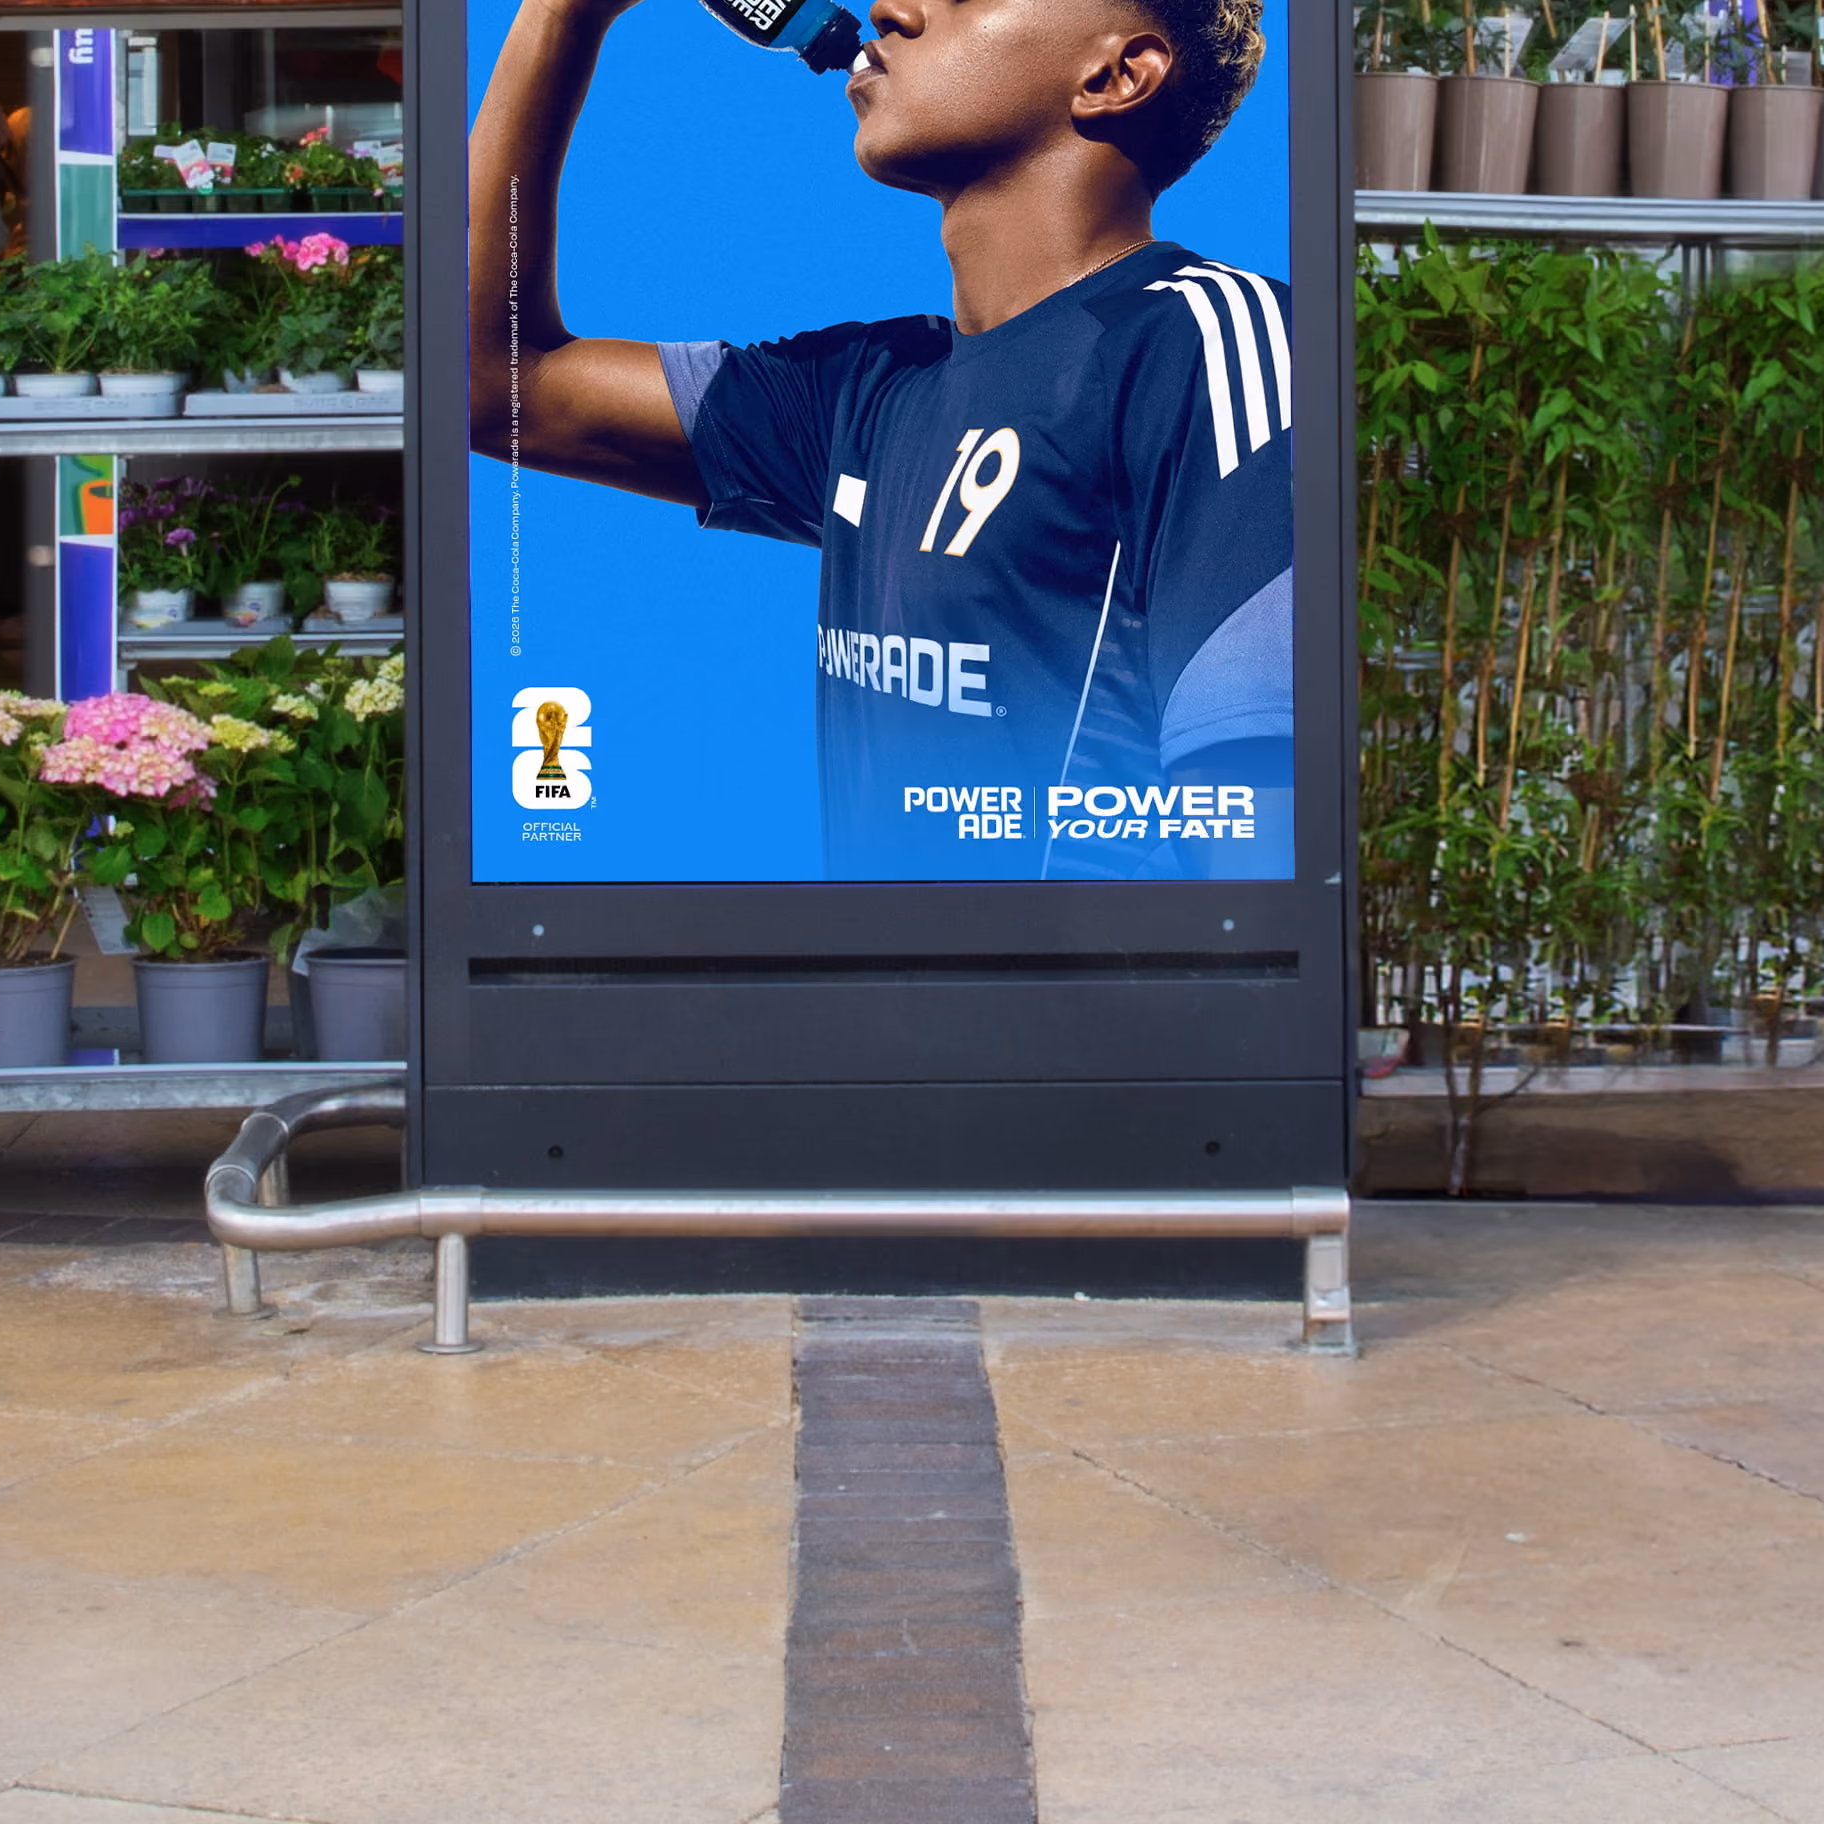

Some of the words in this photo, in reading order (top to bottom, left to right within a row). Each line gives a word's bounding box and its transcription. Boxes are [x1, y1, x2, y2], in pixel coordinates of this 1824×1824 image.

[509, 174, 522, 224] Company.
[509, 225, 519, 279] Coca-Cola
[509, 280, 519, 299] The
[509, 301, 519, 312] of
[509, 313, 520, 365] trademark
[509, 367, 521, 418] registered
[509, 427, 520, 437] is
[509, 439, 520, 489] Powerade
[919, 426, 1021, 558] 19
[510, 489, 522, 541] Company.
[510, 541, 521, 594] Coca-Cola
[511, 595, 521, 614] The
[511, 616, 521, 645] 2026
[535, 784, 572, 799] FIFA
[903, 786, 1022, 812] POWER
[1047, 785, 1256, 817] POWER
[521, 832, 582, 842] PARTNER
[522, 822, 581, 832] OFFICIAL
[958, 812, 1022, 840] ADE
[1047, 819, 1148, 839] YOUR
[1158, 819, 1256, 839] FATE
